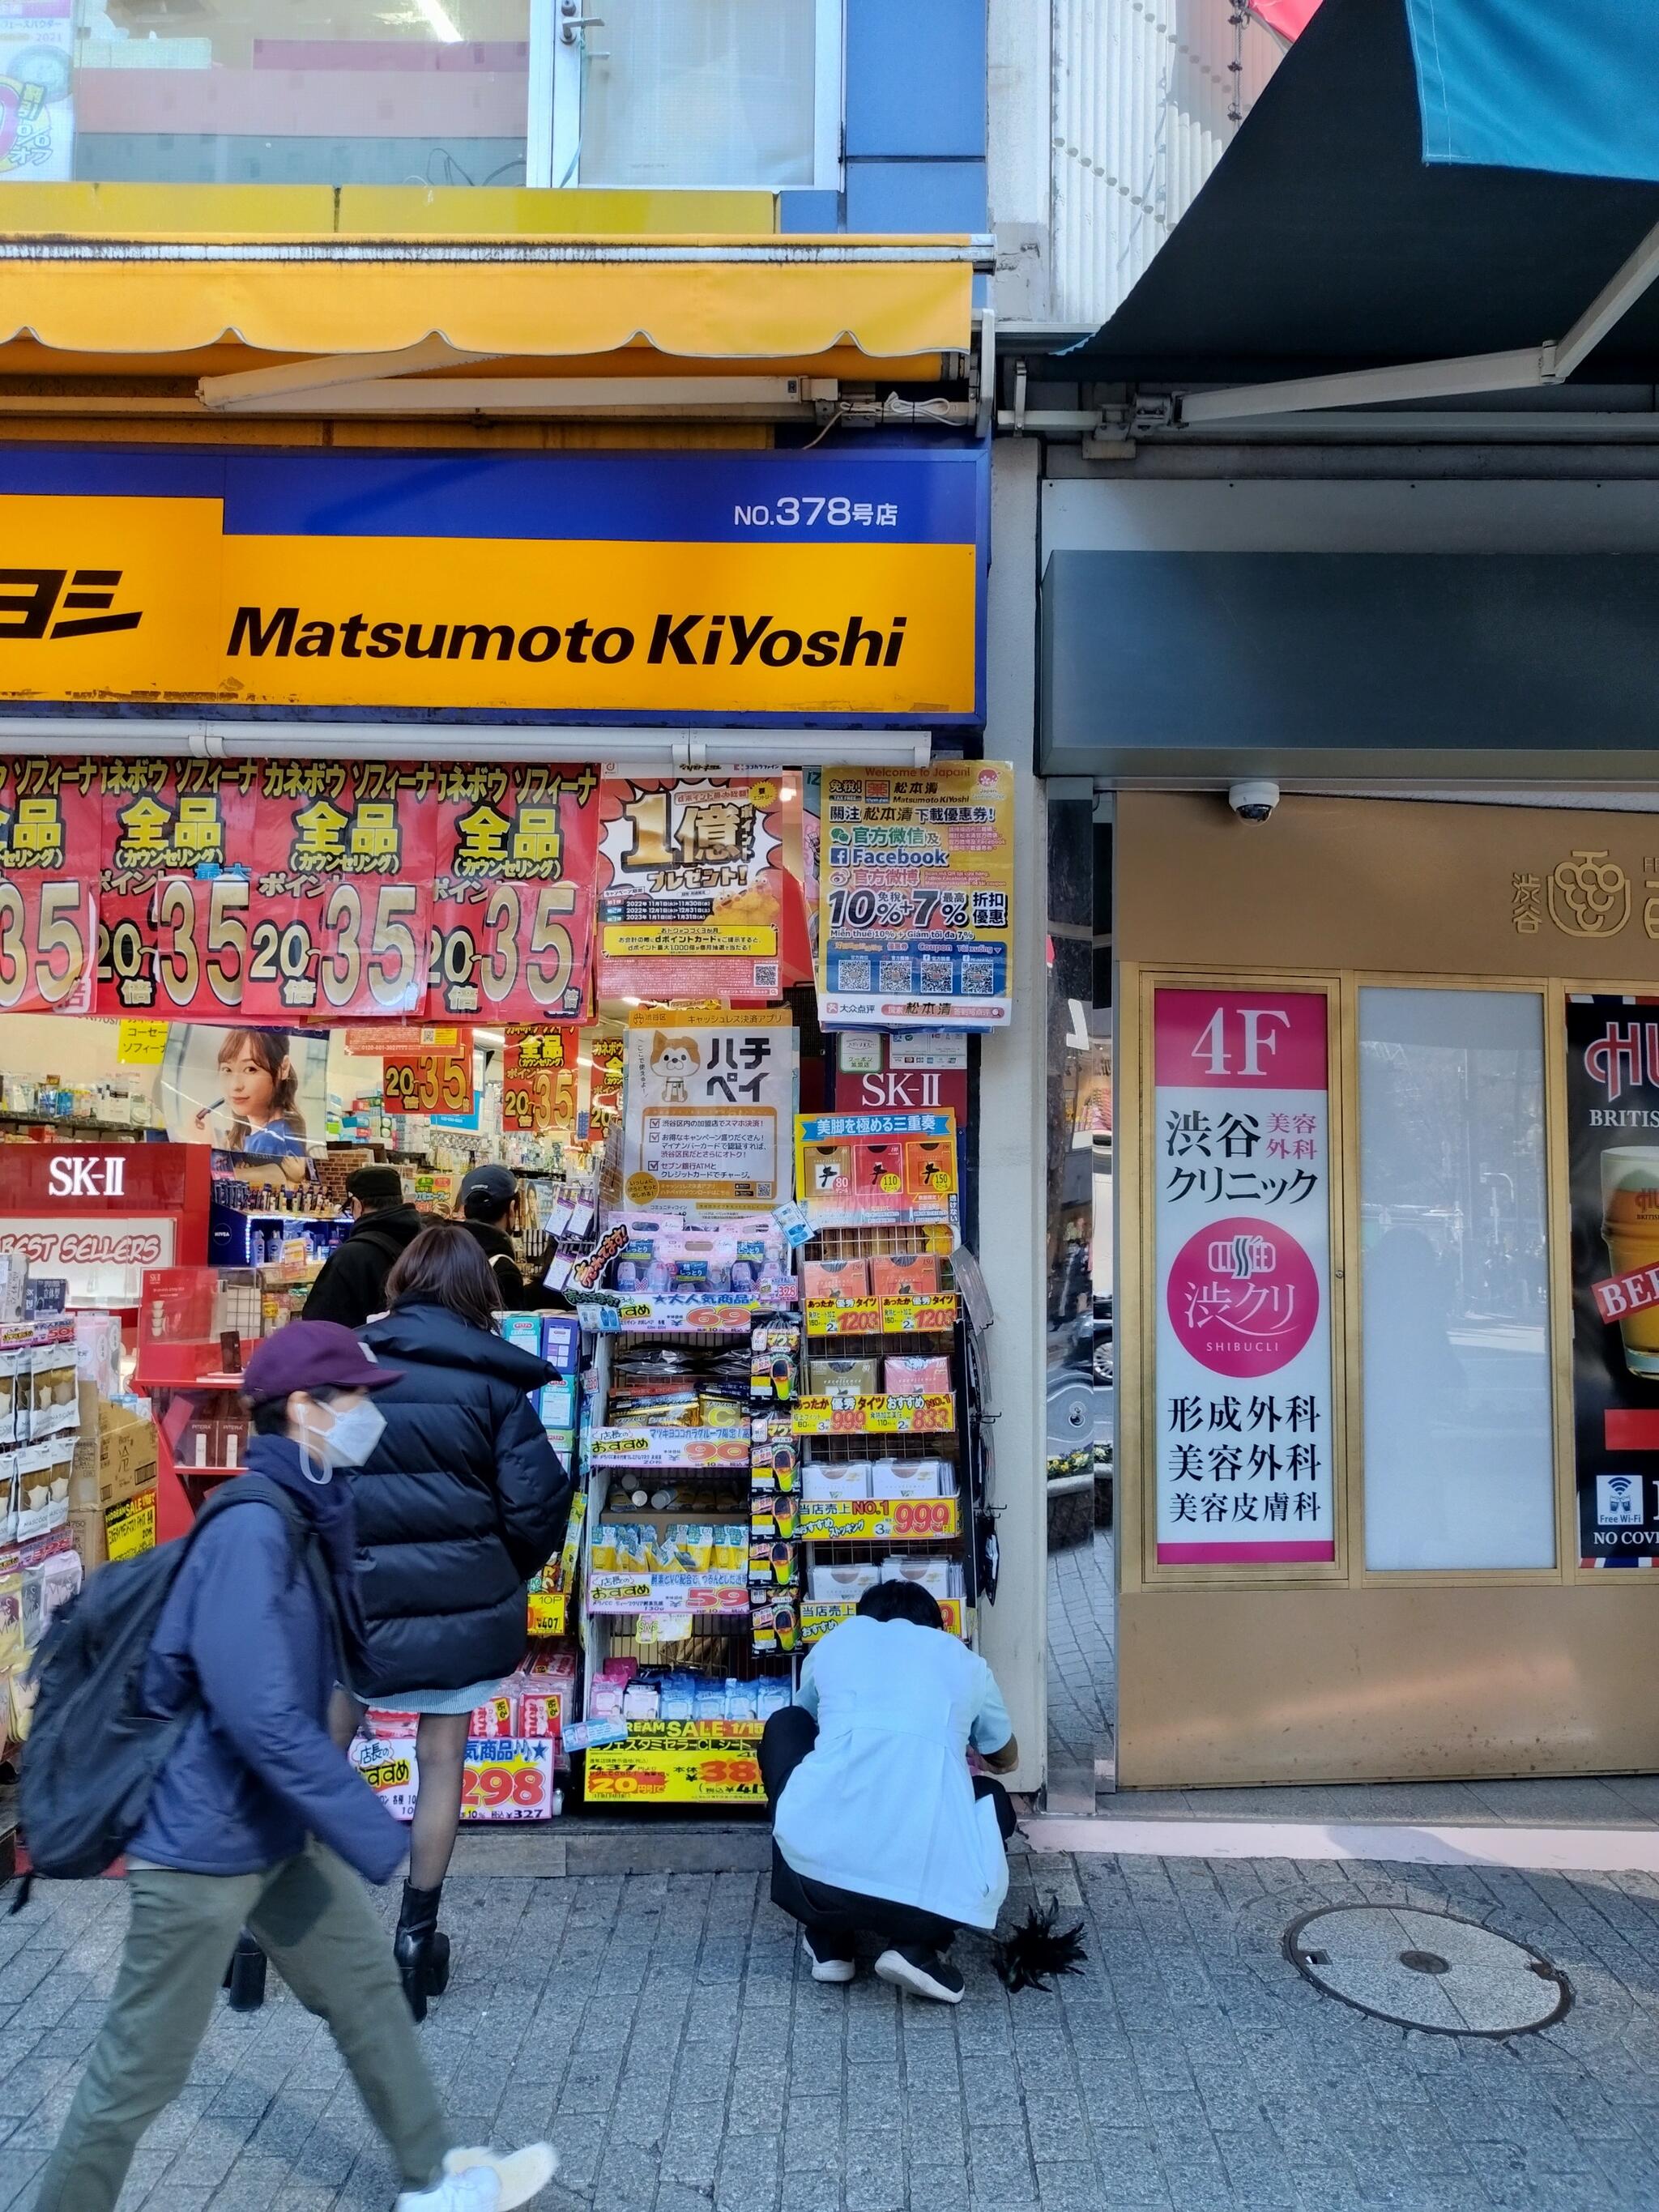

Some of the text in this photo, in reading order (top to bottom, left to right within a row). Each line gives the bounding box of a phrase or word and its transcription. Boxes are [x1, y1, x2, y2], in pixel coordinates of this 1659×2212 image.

[226, 607, 907, 667] Matsumoto KiYoshi
[15, 760, 97, 795] ソフィーナ
[176, 760, 259, 795] ソフィーナ
[263, 762, 437, 801] カネボウ ソフィーナ
[865, 768, 970, 778] Welcome to Japan!
[515, 767, 597, 805] ソフィーナ
[940, 795, 970, 803] KiYoshi
[121, 796, 222, 850] 全品
[296, 801, 398, 856] 全品
[459, 806, 560, 860] 全品
[625, 792, 740, 866] 1億
[740, 803, 756, 861] ポイント
[853, 827, 923, 845] 官方微信
[853, 850, 947, 866] Facebook
[647, 865, 748, 892] プレゼント!
[853, 870, 919, 887] 官方微博
[943, 893, 965, 903] 最高
[973, 893, 1004, 907] 折扣
[1512, 872, 1542, 934] 渋谷
[973, 910, 1004, 924] 優惠
[160, 880, 248, 1007] 35
[322, 884, 416, 1007] 35
[481, 885, 575, 1005] 35
[918, 944, 952, 953] Coupon
[121, 979, 153, 1005] 倍
[284, 979, 317, 1004] 倍
[449, 987, 478, 1010] 倍
[689, 1014, 782, 1024] キャッシュレス決済アプリ
[839, 1005, 875, 1013] 大众点评
[906, 1002, 952, 1016] 松本清
[128, 1027, 168, 1037] コーセー
[1191, 1007, 1290, 1076] 4F
[519, 1035, 563, 1059] 全品
[707, 1038, 771, 1069] ハチ
[706, 1072, 770, 1102] ペイ
[862, 1073, 942, 1106] SK-II
[817, 1115, 936, 1135] 美脚を極める三重奏
[1166, 1110, 1261, 1158] 渋谷
[1265, 1113, 1317, 1134] 美容
[1266, 1139, 1318, 1161] 外科
[48, 1157, 126, 1196] SK-II
[835, 1178, 848, 1187] 80
[884, 1176, 898, 1185] 110
[935, 1175, 948, 1184] 150
[1166, 1166, 1319, 1205] クリニック
[1, 1234, 161, 1264] BEST SELLERS
[667, 1295, 749, 1305] 大人気商品
[808, 1298, 877, 1307] あったか タイツ
[884, 1296, 953, 1306] あったか タイツ
[1183, 1281, 1301, 1336] 渋クリ
[1206, 1341, 1280, 1352] SHIBUCLI
[858, 1396, 885, 1409] タイツ
[887, 1396, 925, 1409] おすすめ
[925, 1395, 951, 1408] NO.1
[1167, 1395, 1321, 1433] 形成外科
[592, 1439, 648, 1454] おすすめ
[1168, 1443, 1321, 1481] 美容外科
[799, 1500, 889, 1515] 当店売上 NO.1
[1169, 1491, 1321, 1523] 美容皮膚科
[830, 1520, 864, 1538] ストッキング
[893, 1502, 950, 1535] 999
[1620, 1515, 1641, 1523] Wi-Fi
[1593, 1532, 1618, 1545] NO
[539, 1596, 562, 1605] 10P
[592, 1585, 650, 1599] おすすめ
[802, 1605, 856, 1616] 当店売上
[802, 1620, 838, 1637] おすすめ
[495, 1700, 509, 1717] 貼る
[546, 1698, 558, 1716] 貼る
[627, 1722, 665, 1733] REAM
[667, 1720, 724, 1737] SALE
[360, 1743, 390, 1764] 店長の
[462, 1768, 546, 1807] 298
[592, 1777, 637, 1792] 20
